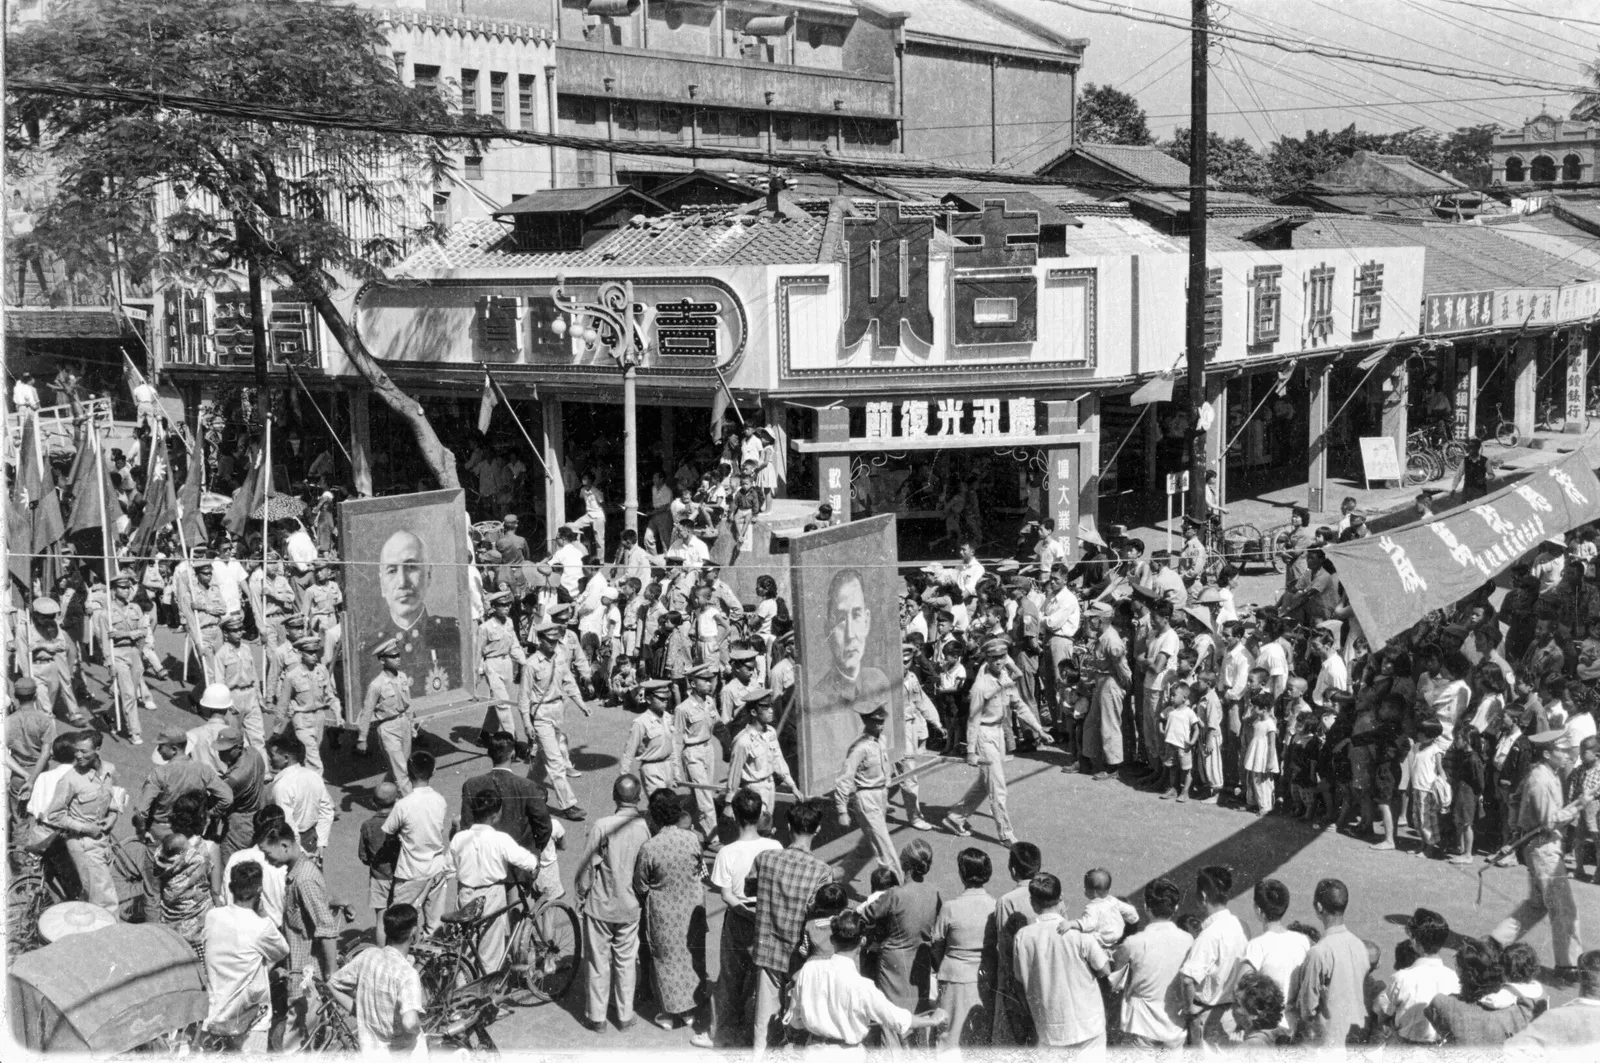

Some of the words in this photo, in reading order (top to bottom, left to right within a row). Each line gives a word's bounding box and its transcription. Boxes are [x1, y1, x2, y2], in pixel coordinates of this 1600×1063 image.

[828, 467, 842, 525] 歡迎
[1057, 459, 1071, 556] 擴大業務
